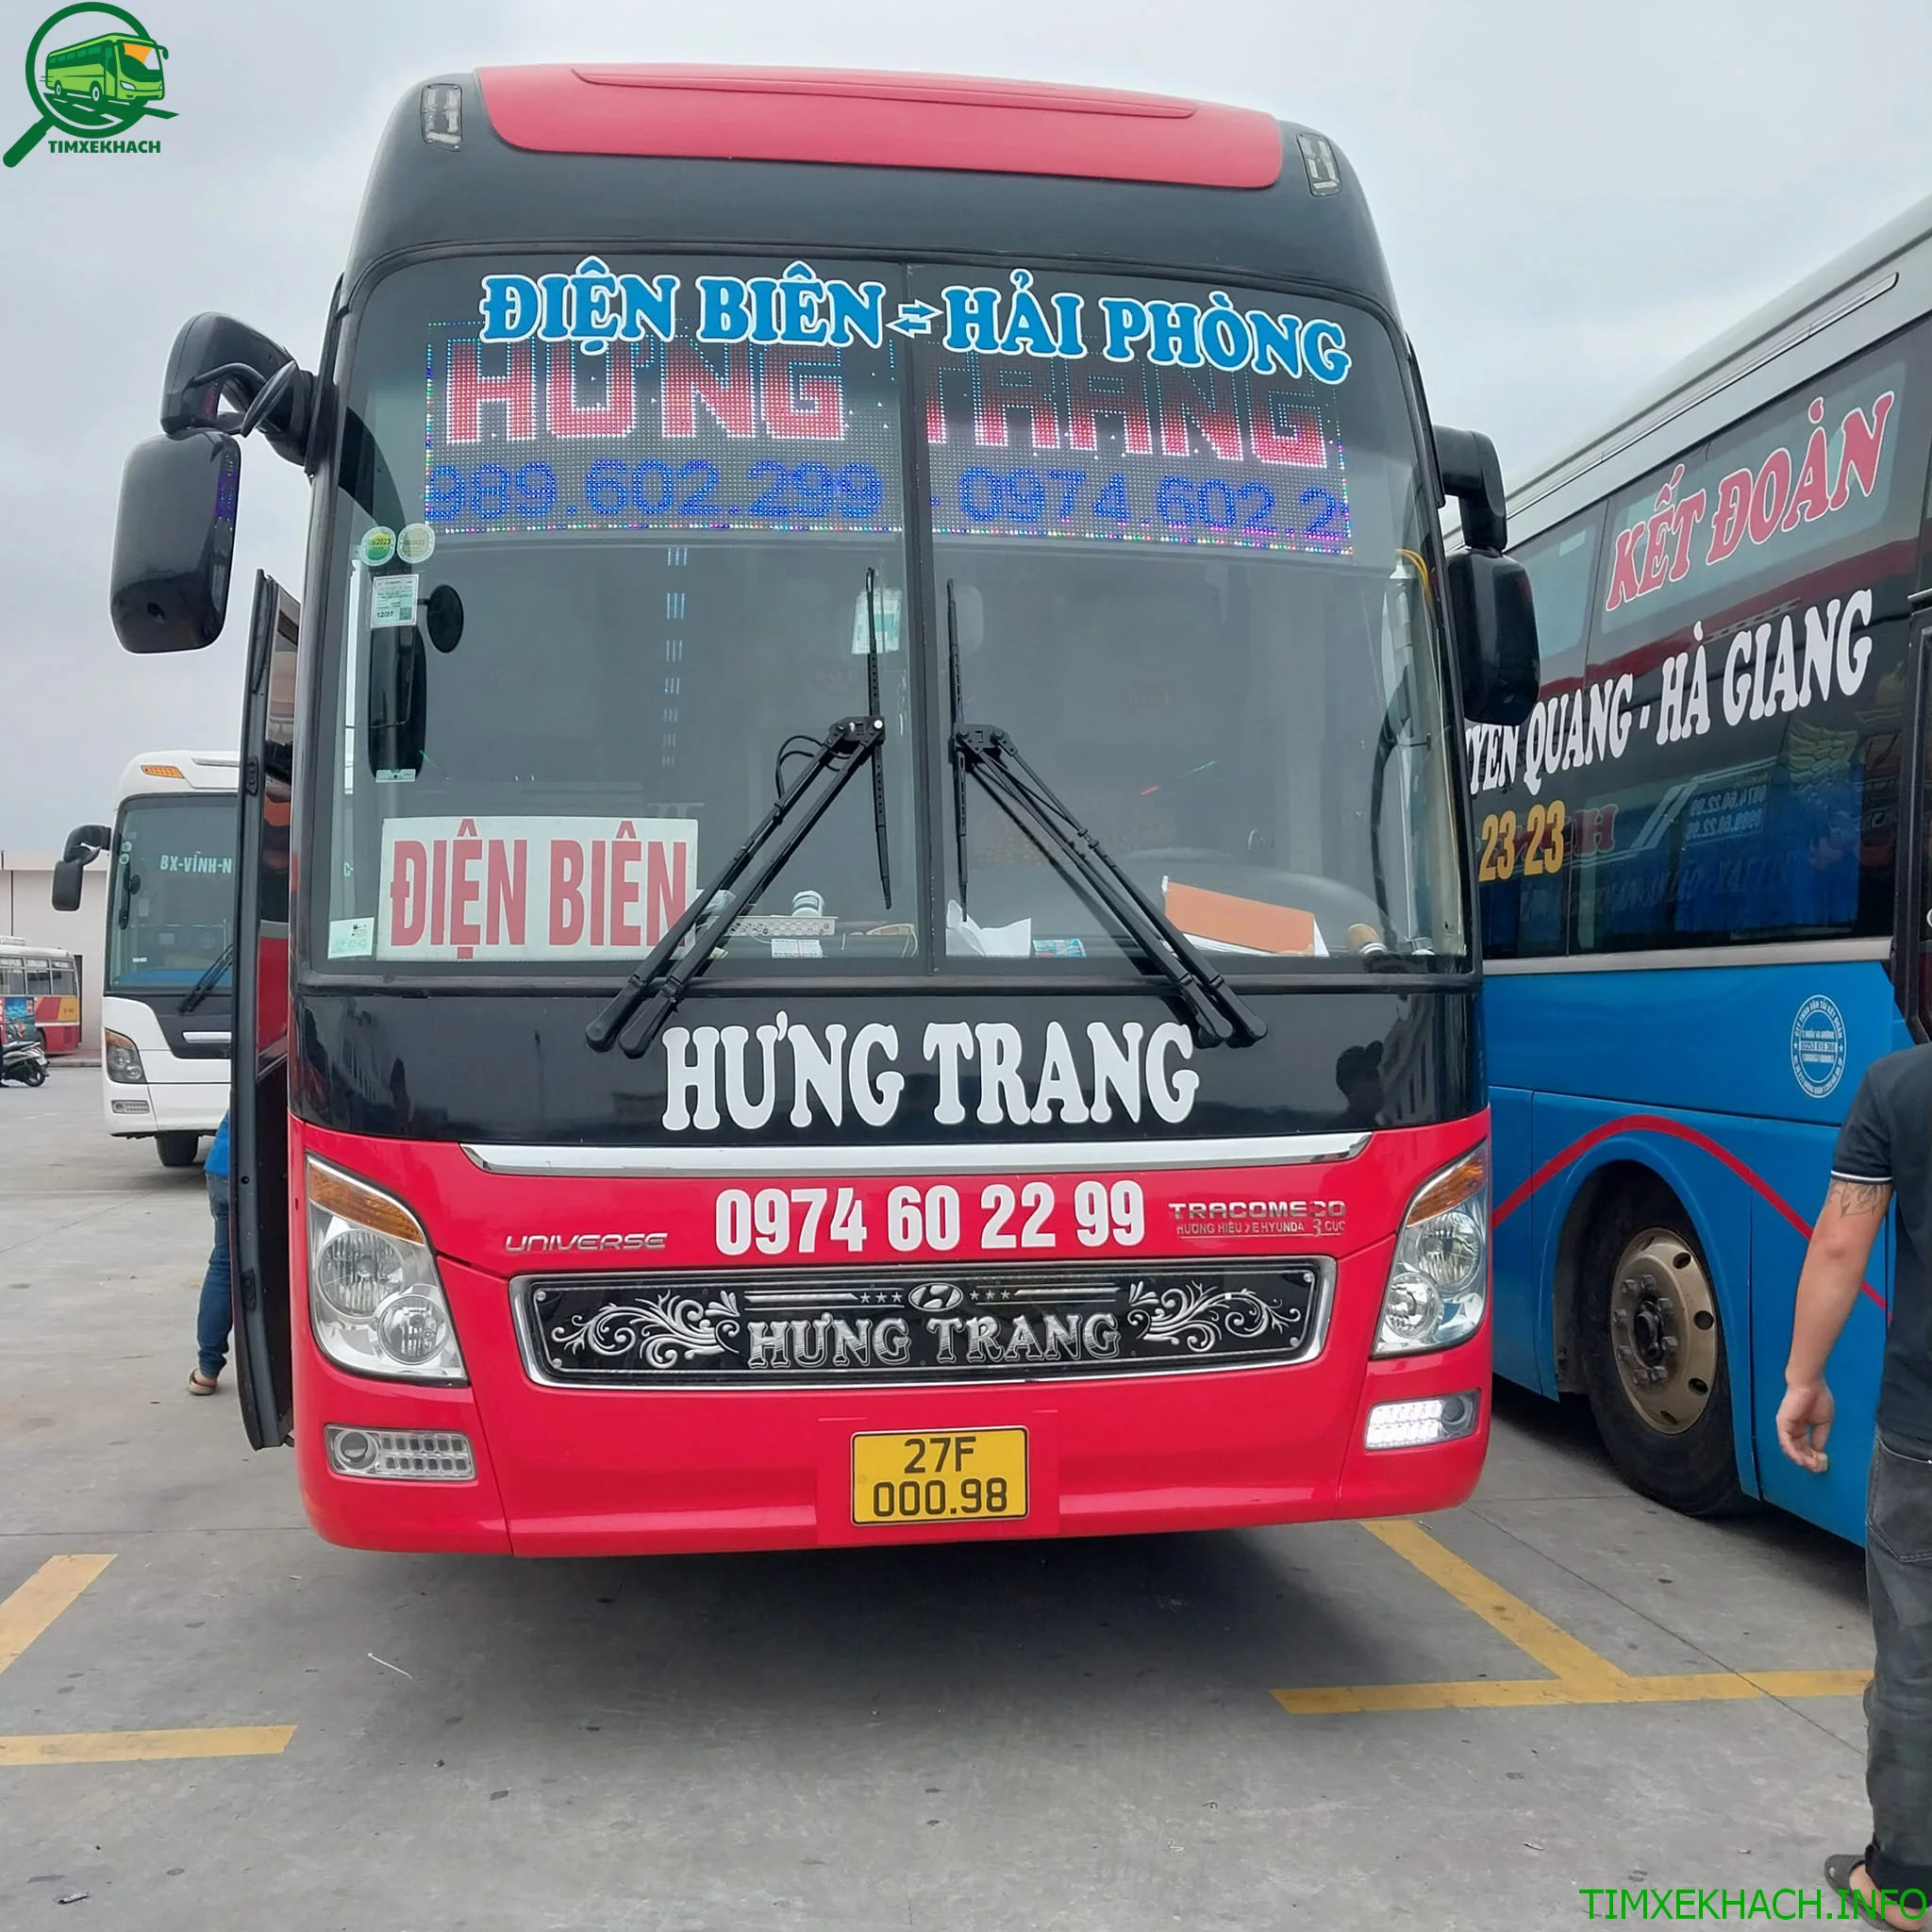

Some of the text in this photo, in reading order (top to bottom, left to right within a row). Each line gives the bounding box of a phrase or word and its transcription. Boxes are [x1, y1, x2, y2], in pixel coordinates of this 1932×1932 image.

[479, 256, 1352, 385] ĐIỆN BIÊN HẢI PHÒNG
[958, 465, 1351, 541] 0974.602.2
[1606, 462, 1707, 612] KẾT
[1524, 672, 1635, 795] QUANG
[1723, 588, 1873, 726] GIANG
[1479, 810, 1517, 882] 23
[1524, 799, 1566, 876] 23
[390, 818, 687, 959] ĐIỆN BIÊN
[661, 1010, 1200, 1131] HƯNG TRANG
[505, 1232, 668, 1253] UNIVERSE
[715, 1180, 1144, 1256] 0974 60 22 99
[748, 1311, 1122, 1370] HƯNG TRANG
[904, 1436, 977, 1474] 27F
[873, 1476, 1008, 1517] 000.98
